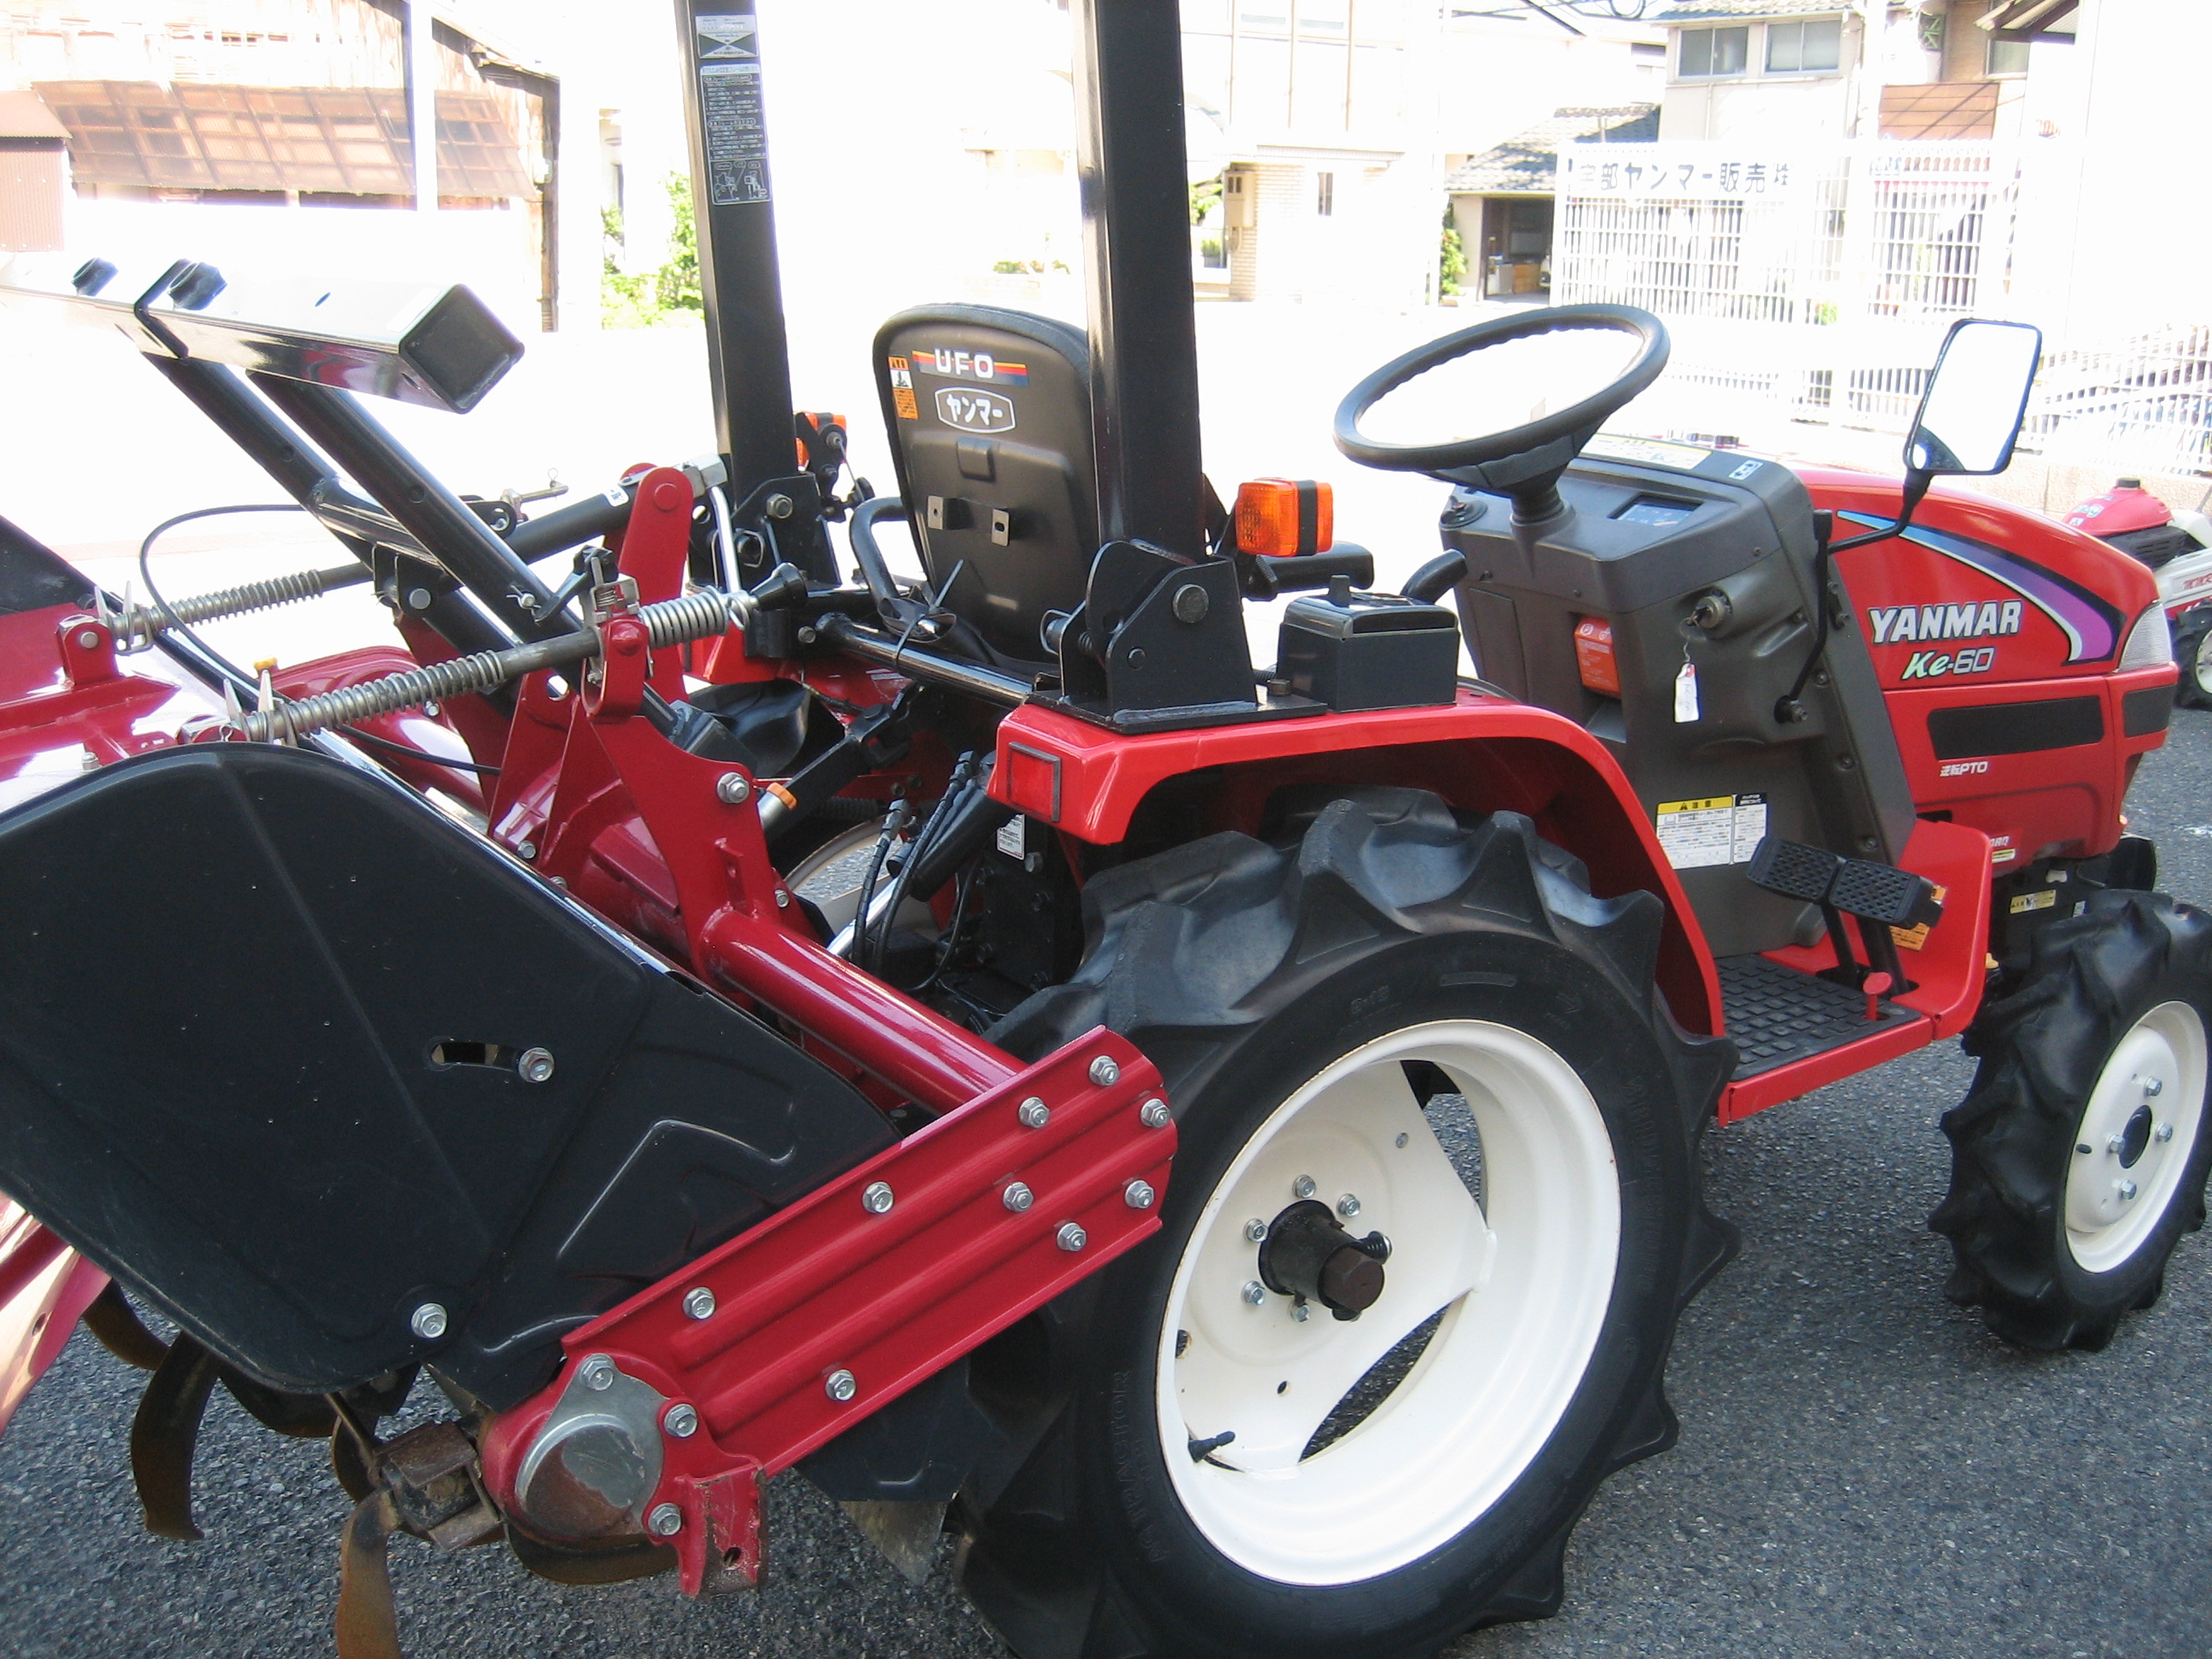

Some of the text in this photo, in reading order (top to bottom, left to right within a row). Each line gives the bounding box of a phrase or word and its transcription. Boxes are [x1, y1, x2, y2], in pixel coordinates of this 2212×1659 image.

[934, 348, 994, 379] UFO
[946, 393, 1004, 427] ヤンマー
[1868, 600, 2023, 644] YANMAR
[1901, 647, 1994, 680] Ke-60
